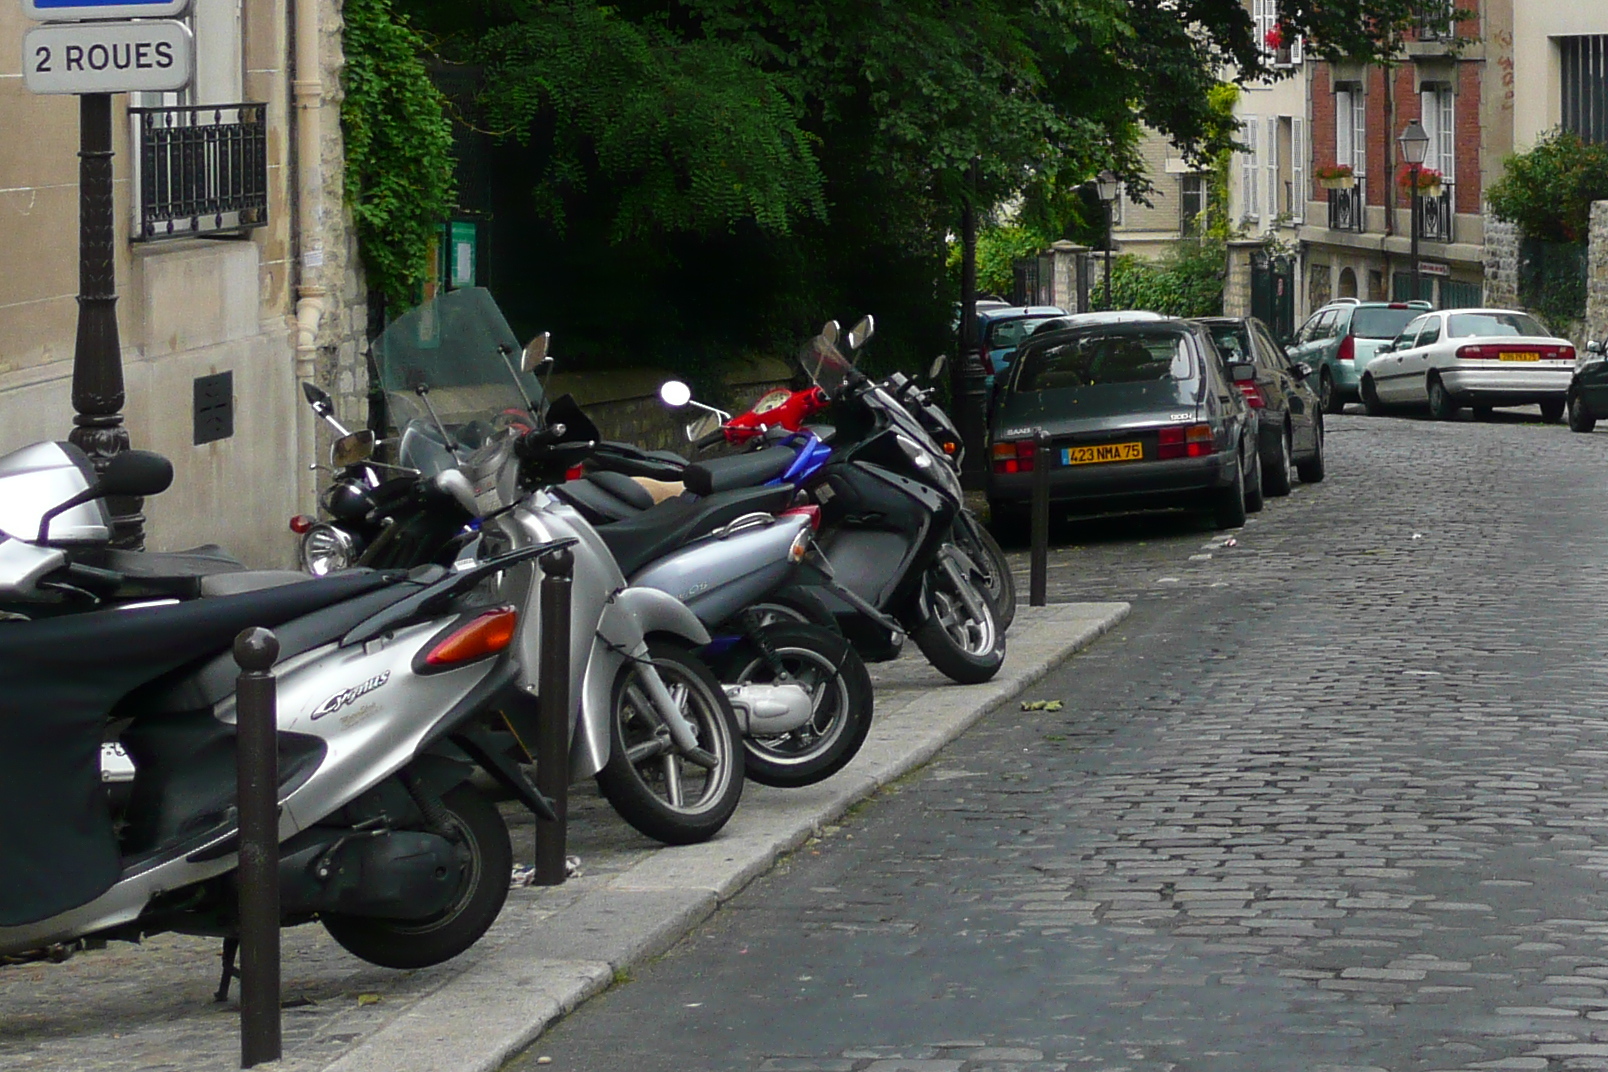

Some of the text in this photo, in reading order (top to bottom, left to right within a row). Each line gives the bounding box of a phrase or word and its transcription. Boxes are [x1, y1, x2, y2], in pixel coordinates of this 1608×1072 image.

[35, 41, 174, 73] 2 ROUES
[1006, 427, 1031, 436] SAAB
[1070, 444, 1140, 462] 423 NMA 75
[311, 669, 391, 720] Cygnus
